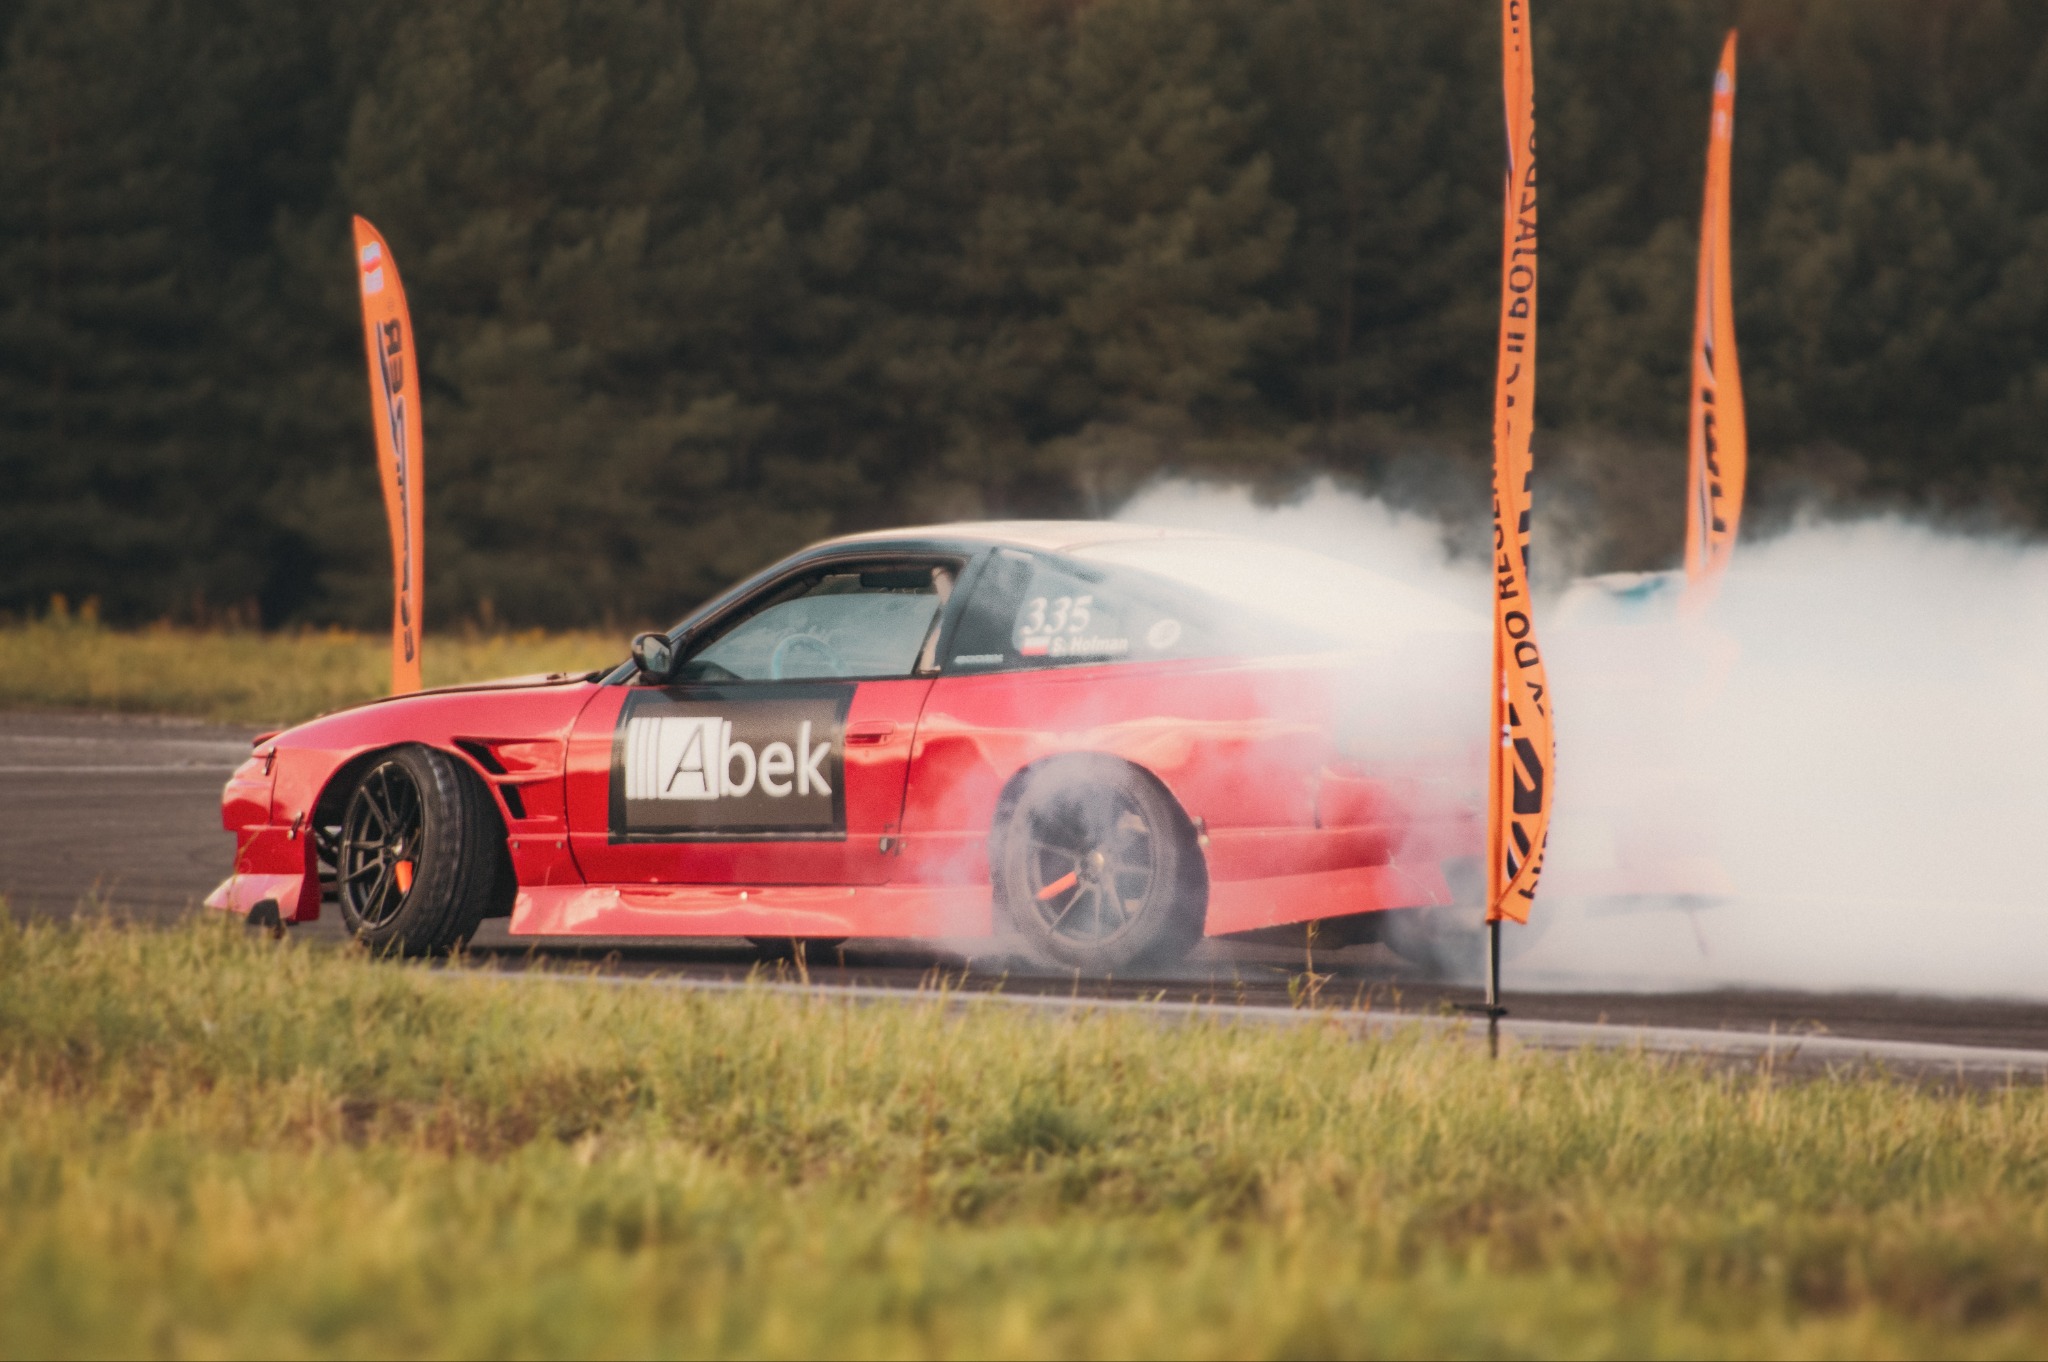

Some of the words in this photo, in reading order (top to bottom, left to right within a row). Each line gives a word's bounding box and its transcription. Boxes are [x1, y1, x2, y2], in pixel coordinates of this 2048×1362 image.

[1020, 595, 1094, 635] 335
[1504, 610, 1540, 669] DO
[662, 718, 833, 798] Abek
